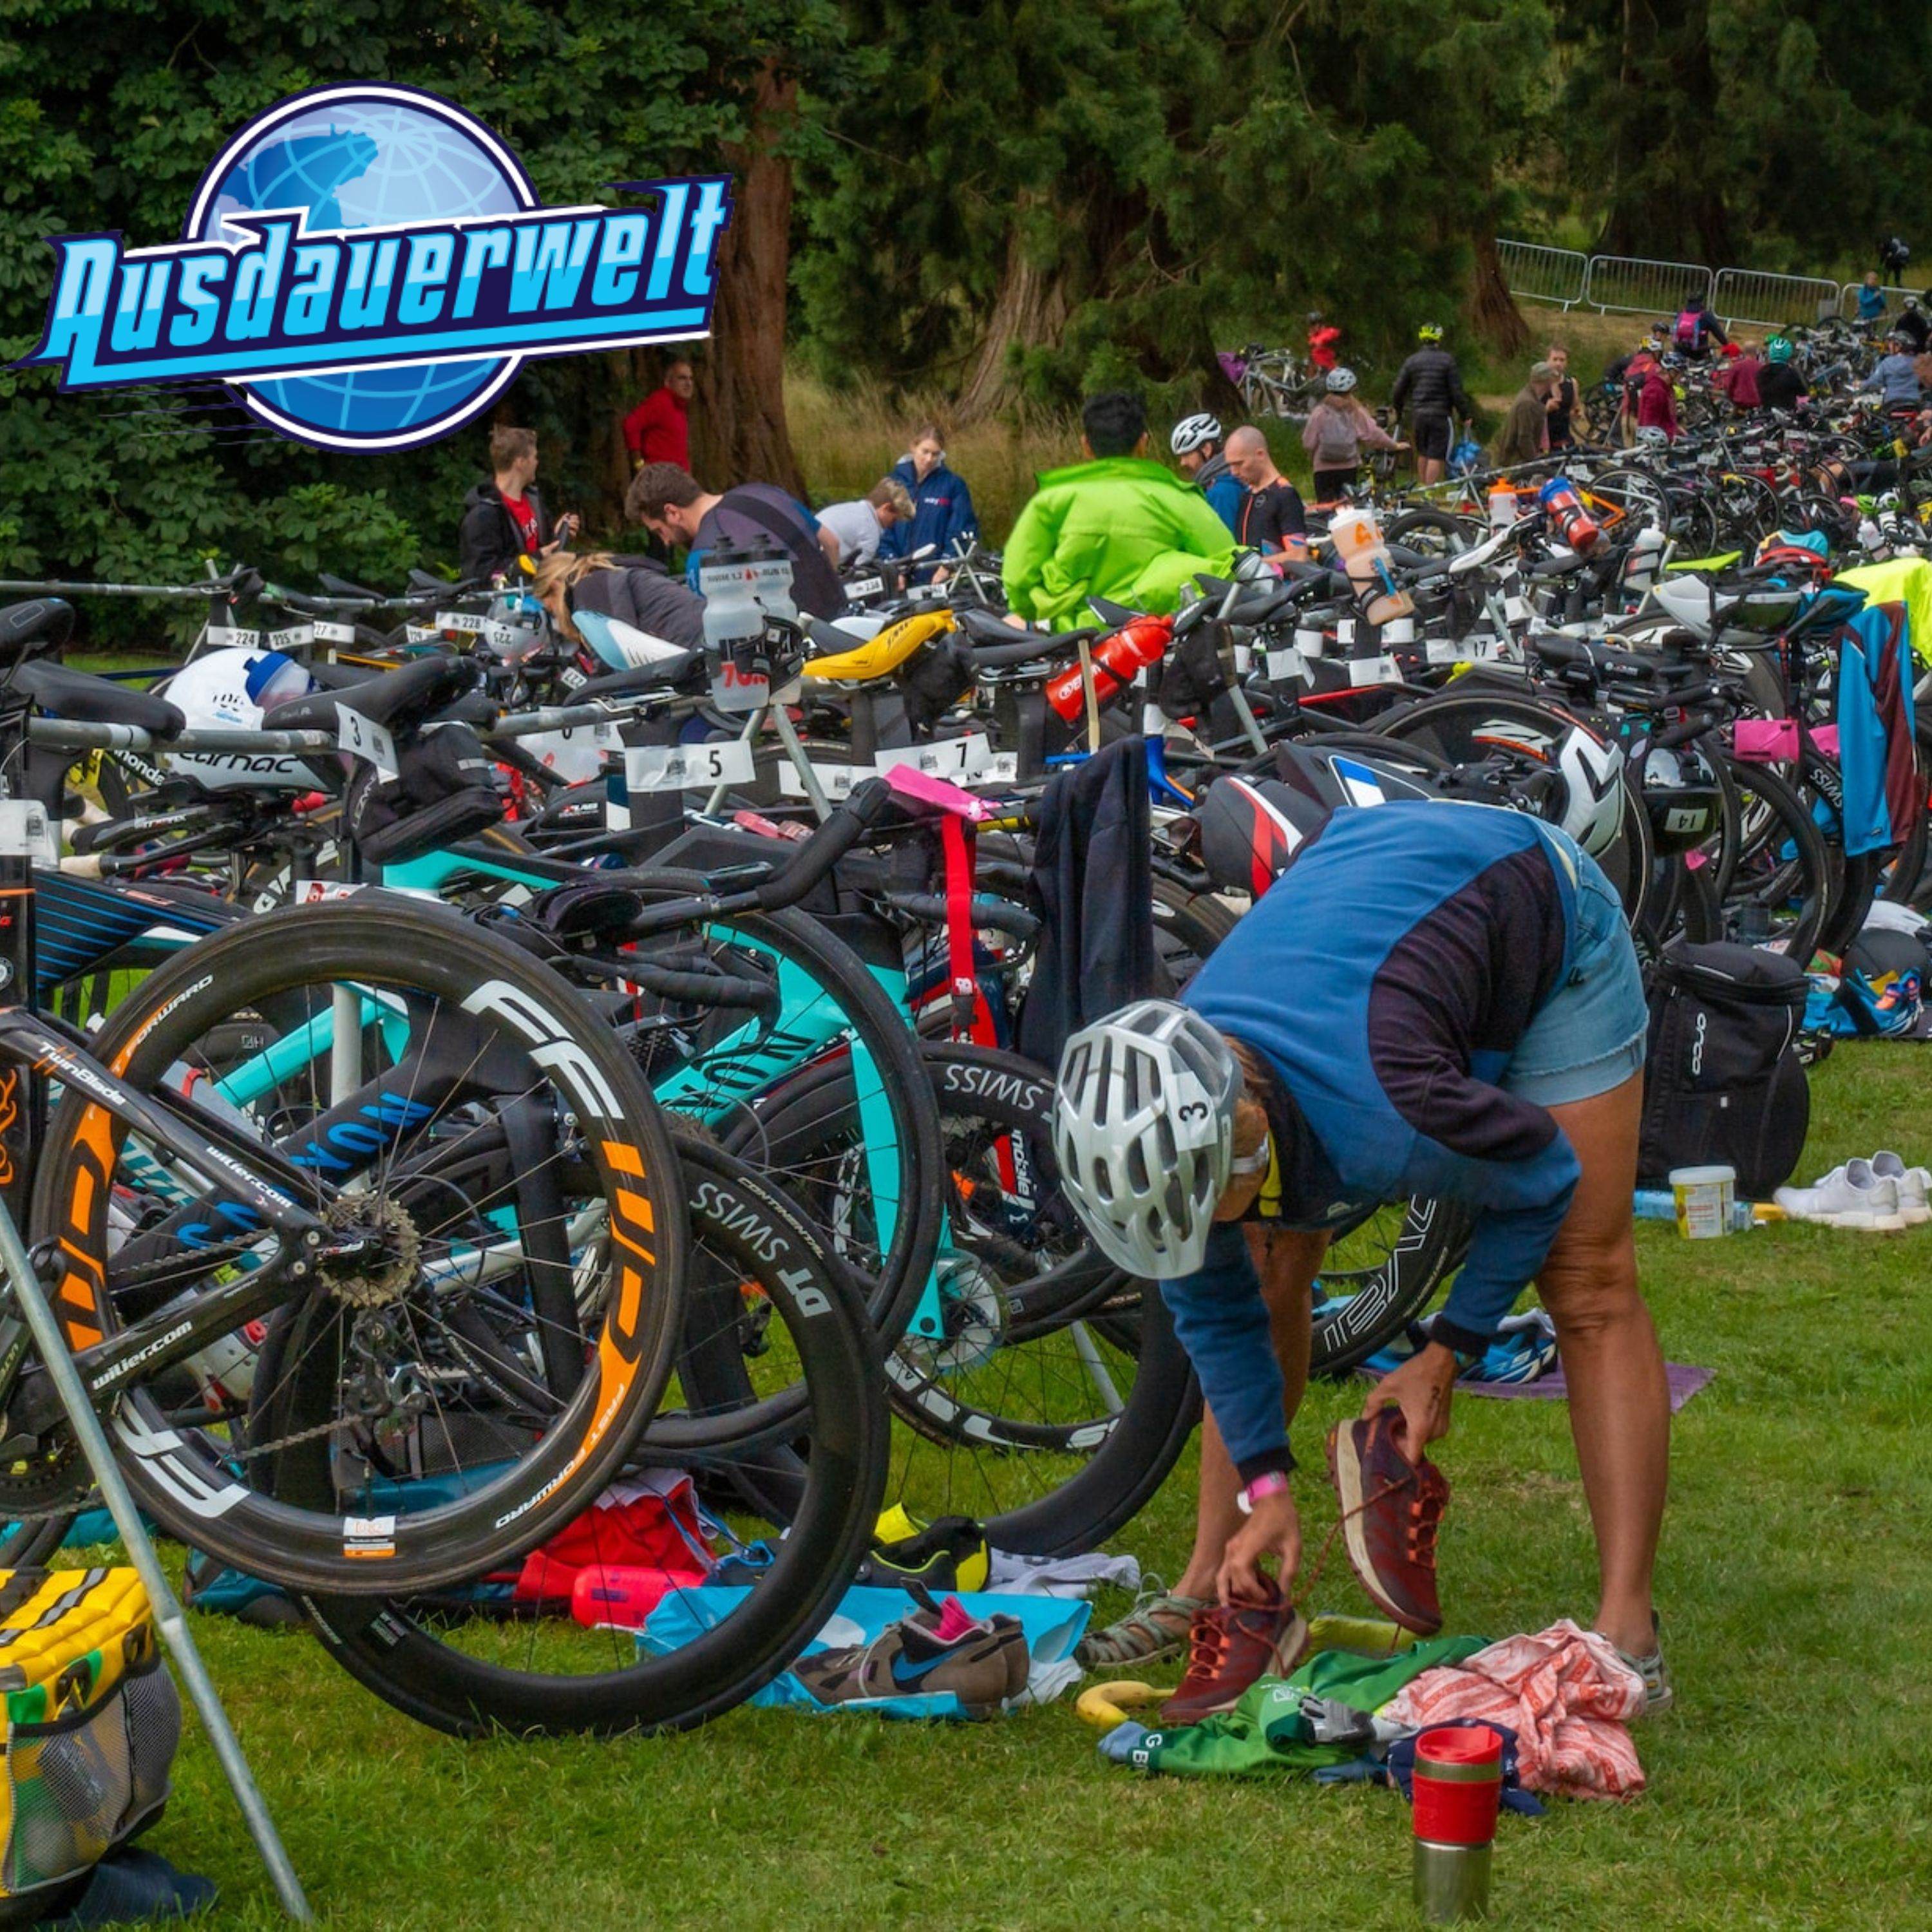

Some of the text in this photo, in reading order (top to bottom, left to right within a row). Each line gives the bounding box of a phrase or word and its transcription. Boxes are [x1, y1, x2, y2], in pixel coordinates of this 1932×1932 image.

[236, 632, 255, 643] 224
[462, 618, 481, 629] 228
[1473, 641, 1487, 657] 17
[350, 715, 361, 747] 3
[709, 750, 722, 777] 5
[956, 742, 967, 768] 7
[39, 1041, 127, 1106] TwinBlade
[945, 1065, 1045, 1112] SWISS
[1179, 1102, 1208, 1122] 3
[206, 1146, 293, 1208] wilier.com
[689, 1182, 790, 1262] SWISS
[92, 1321, 193, 1391] wilier.com
